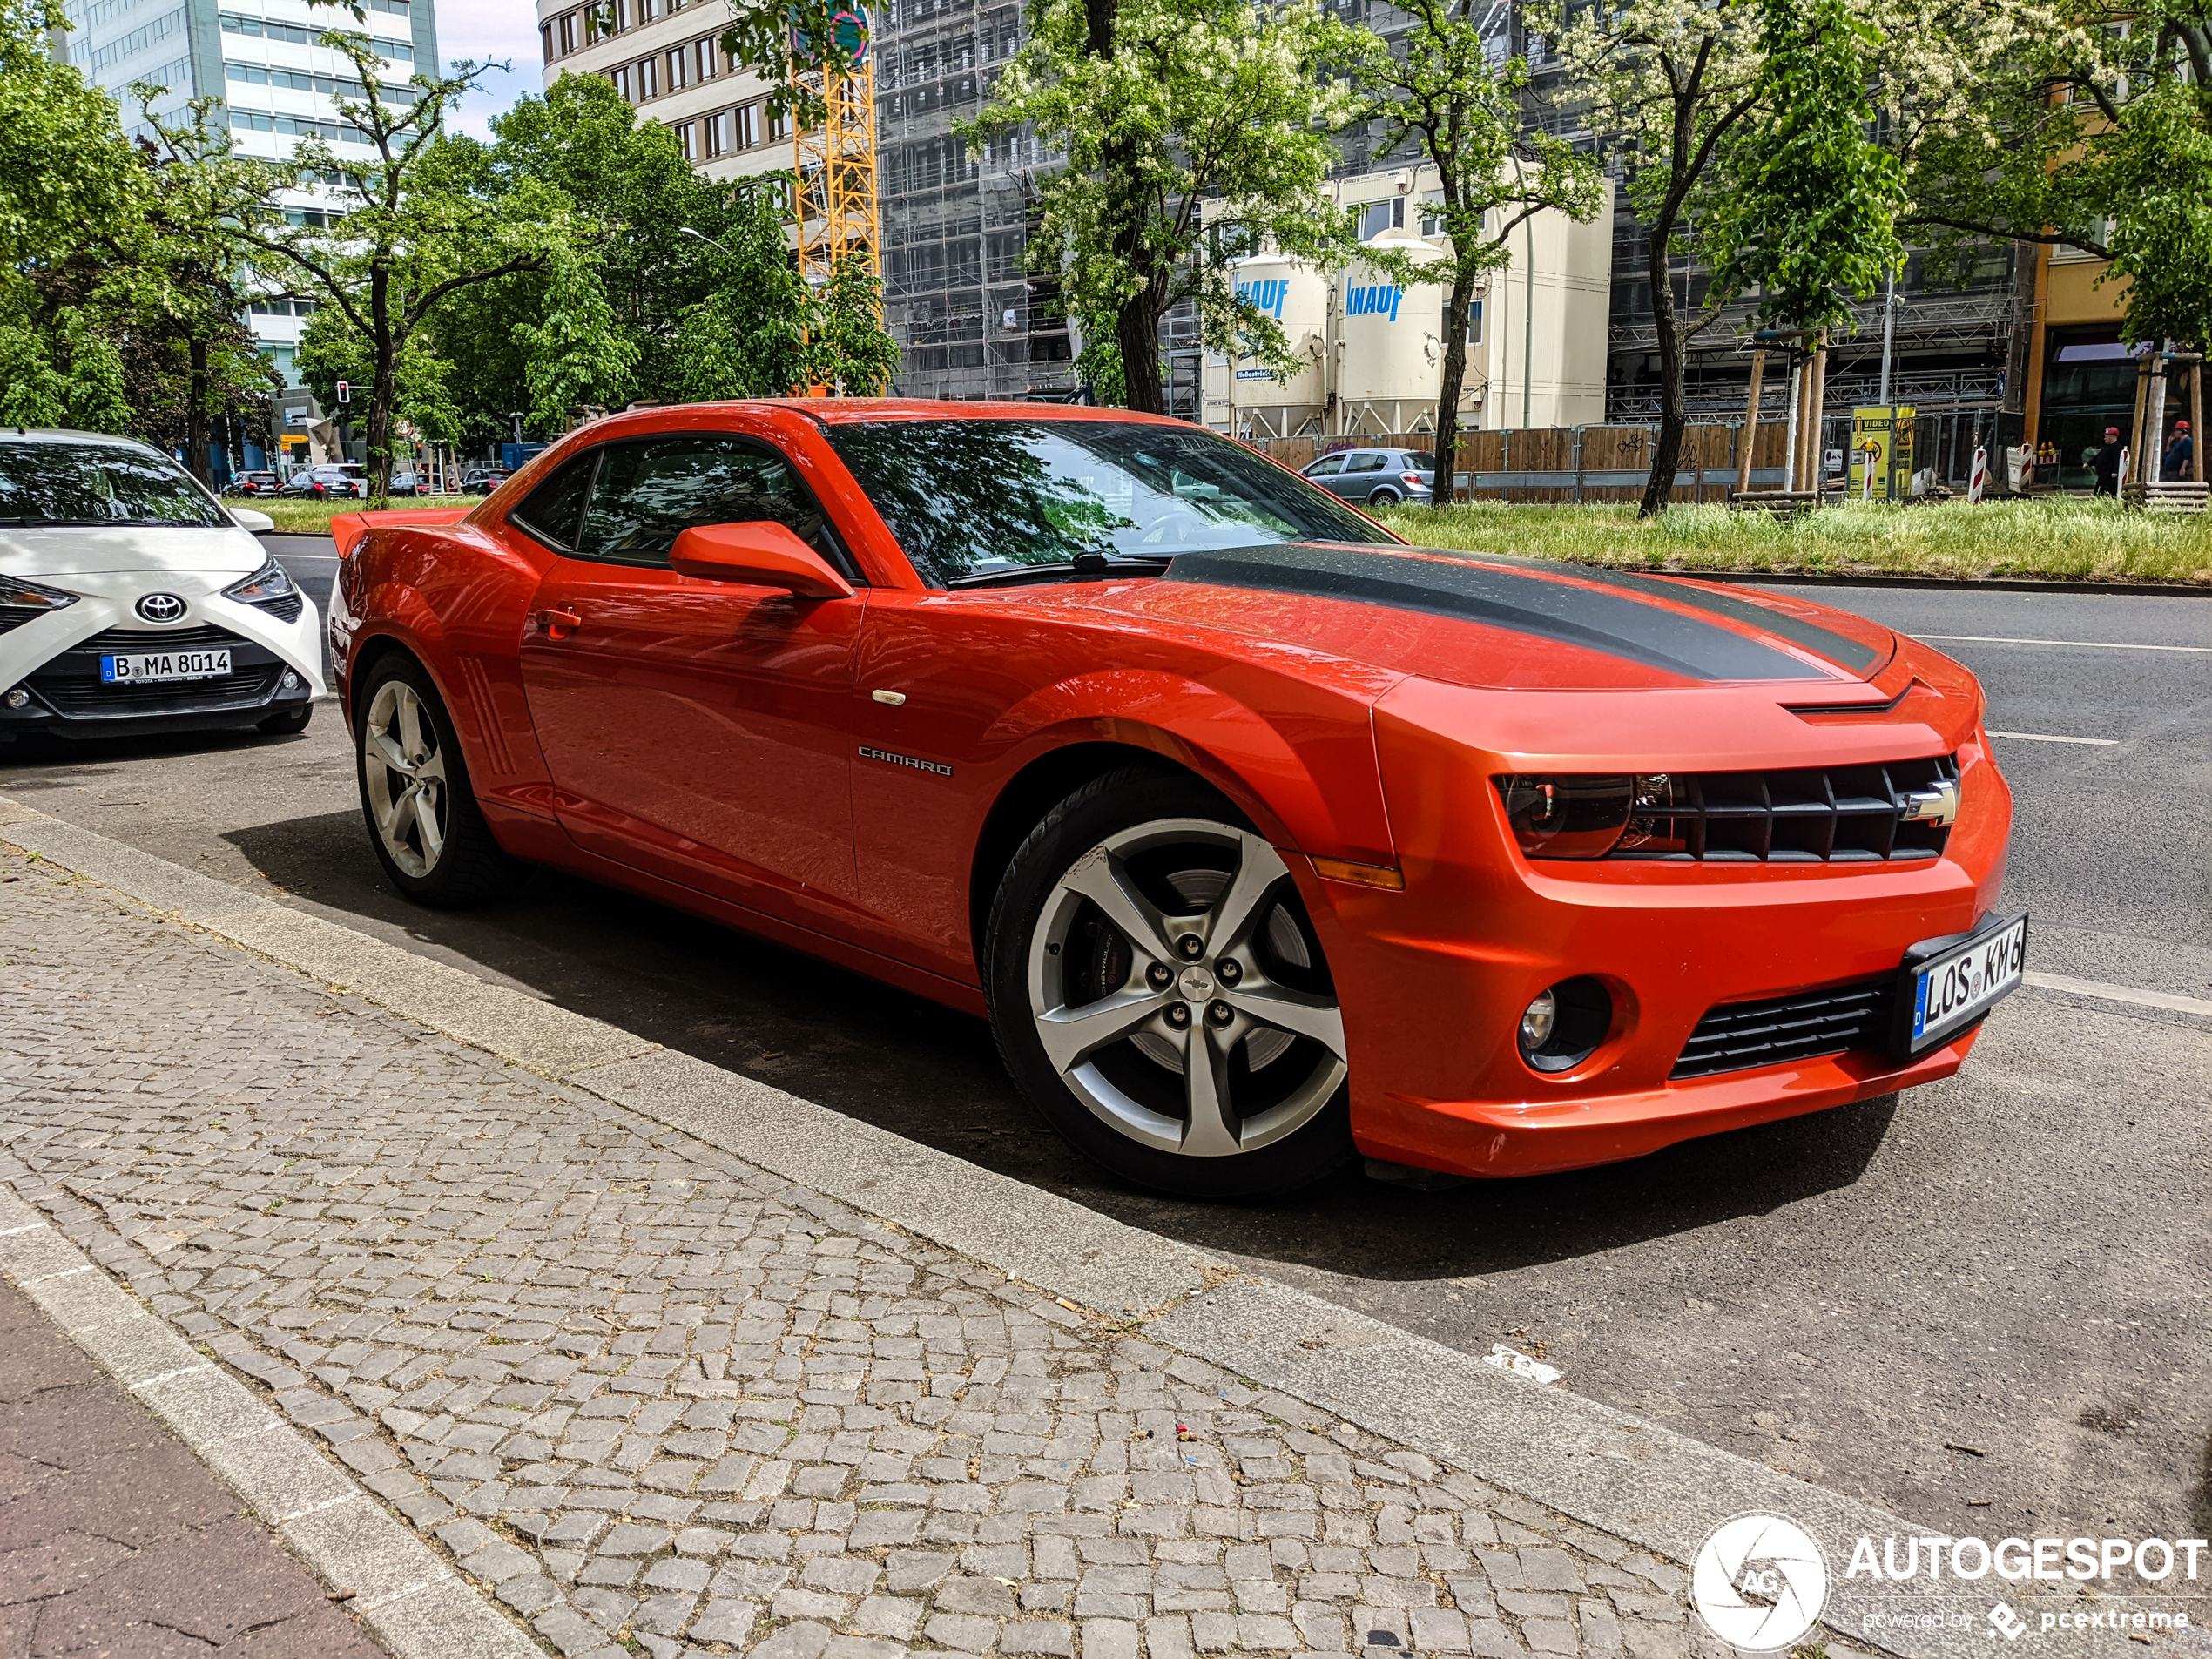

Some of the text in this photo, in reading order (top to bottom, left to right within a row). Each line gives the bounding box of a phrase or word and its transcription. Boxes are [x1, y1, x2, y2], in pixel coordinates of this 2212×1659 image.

[1345, 276, 1403, 321] KNAUF
[116, 658, 130, 677] B
[145, 656, 172, 676] MA
[178, 652, 228, 673] 8014
[858, 745, 953, 776] CAMARO
[1101, 934, 1113, 995] CHEVROLET
[1925, 956, 1972, 1025] LOS
